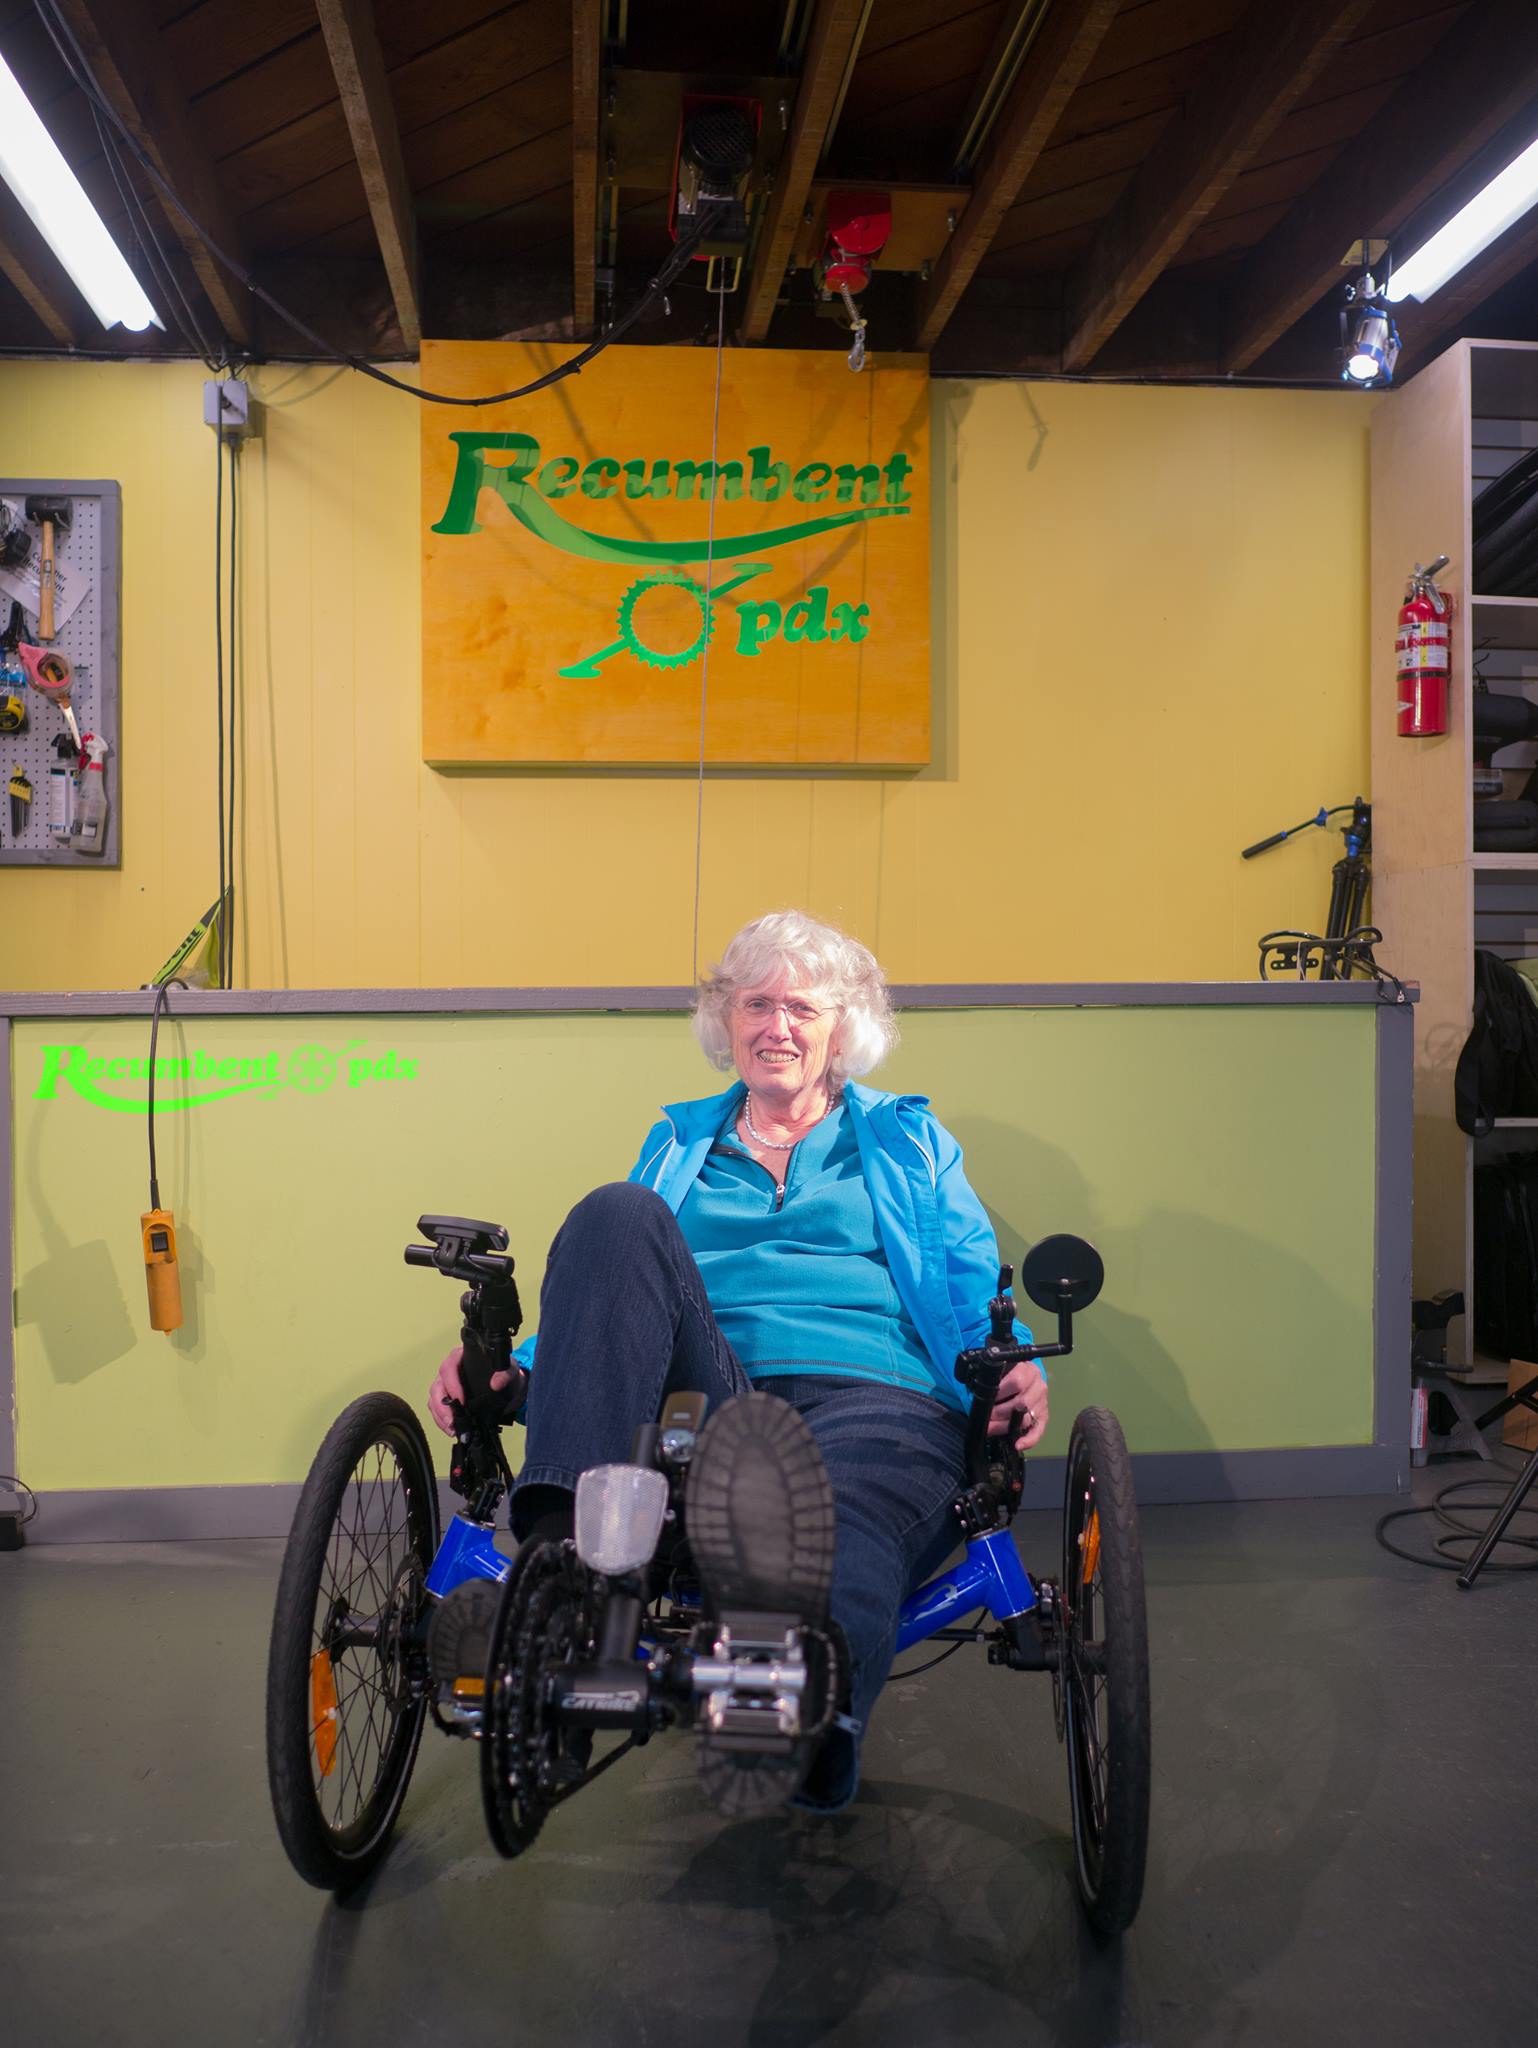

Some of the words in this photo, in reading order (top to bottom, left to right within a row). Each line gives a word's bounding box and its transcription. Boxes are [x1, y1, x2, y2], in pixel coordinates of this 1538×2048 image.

[431, 432, 913, 566] Recumbent
[735, 587, 871, 656] pdx
[32, 1045, 281, 1114] Recumbent
[347, 1050, 420, 1088] pdx
